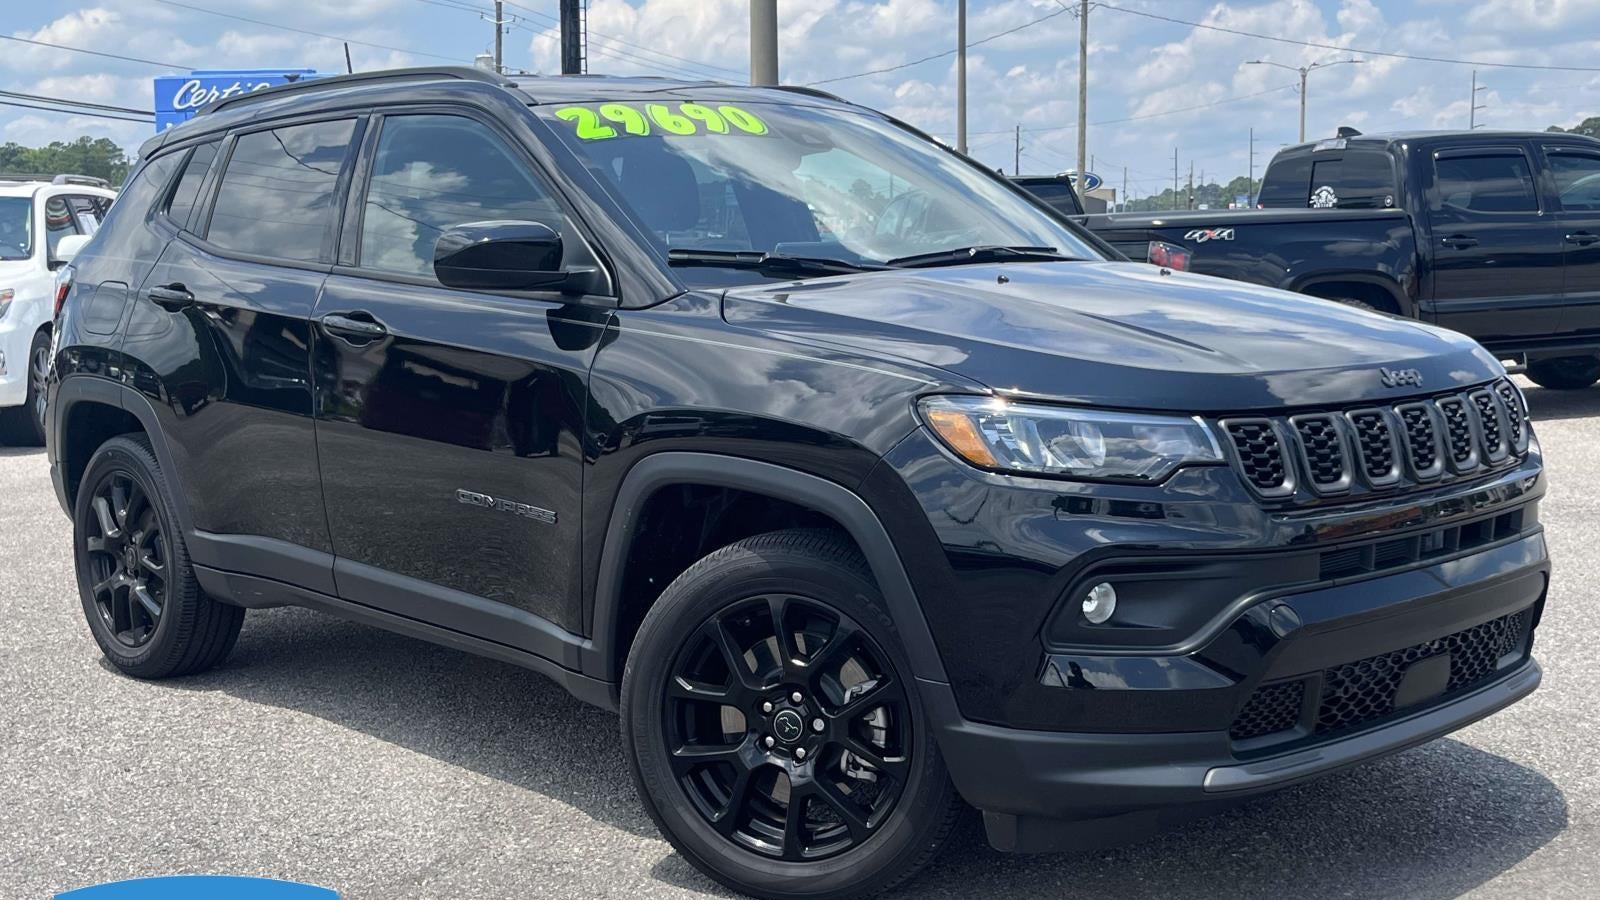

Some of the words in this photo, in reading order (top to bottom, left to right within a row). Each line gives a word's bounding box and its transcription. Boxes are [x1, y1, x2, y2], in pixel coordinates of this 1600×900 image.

[555, 104, 768, 139] 29690
[1380, 367, 1423, 388] Jeep
[456, 488, 557, 526] COMPASS
